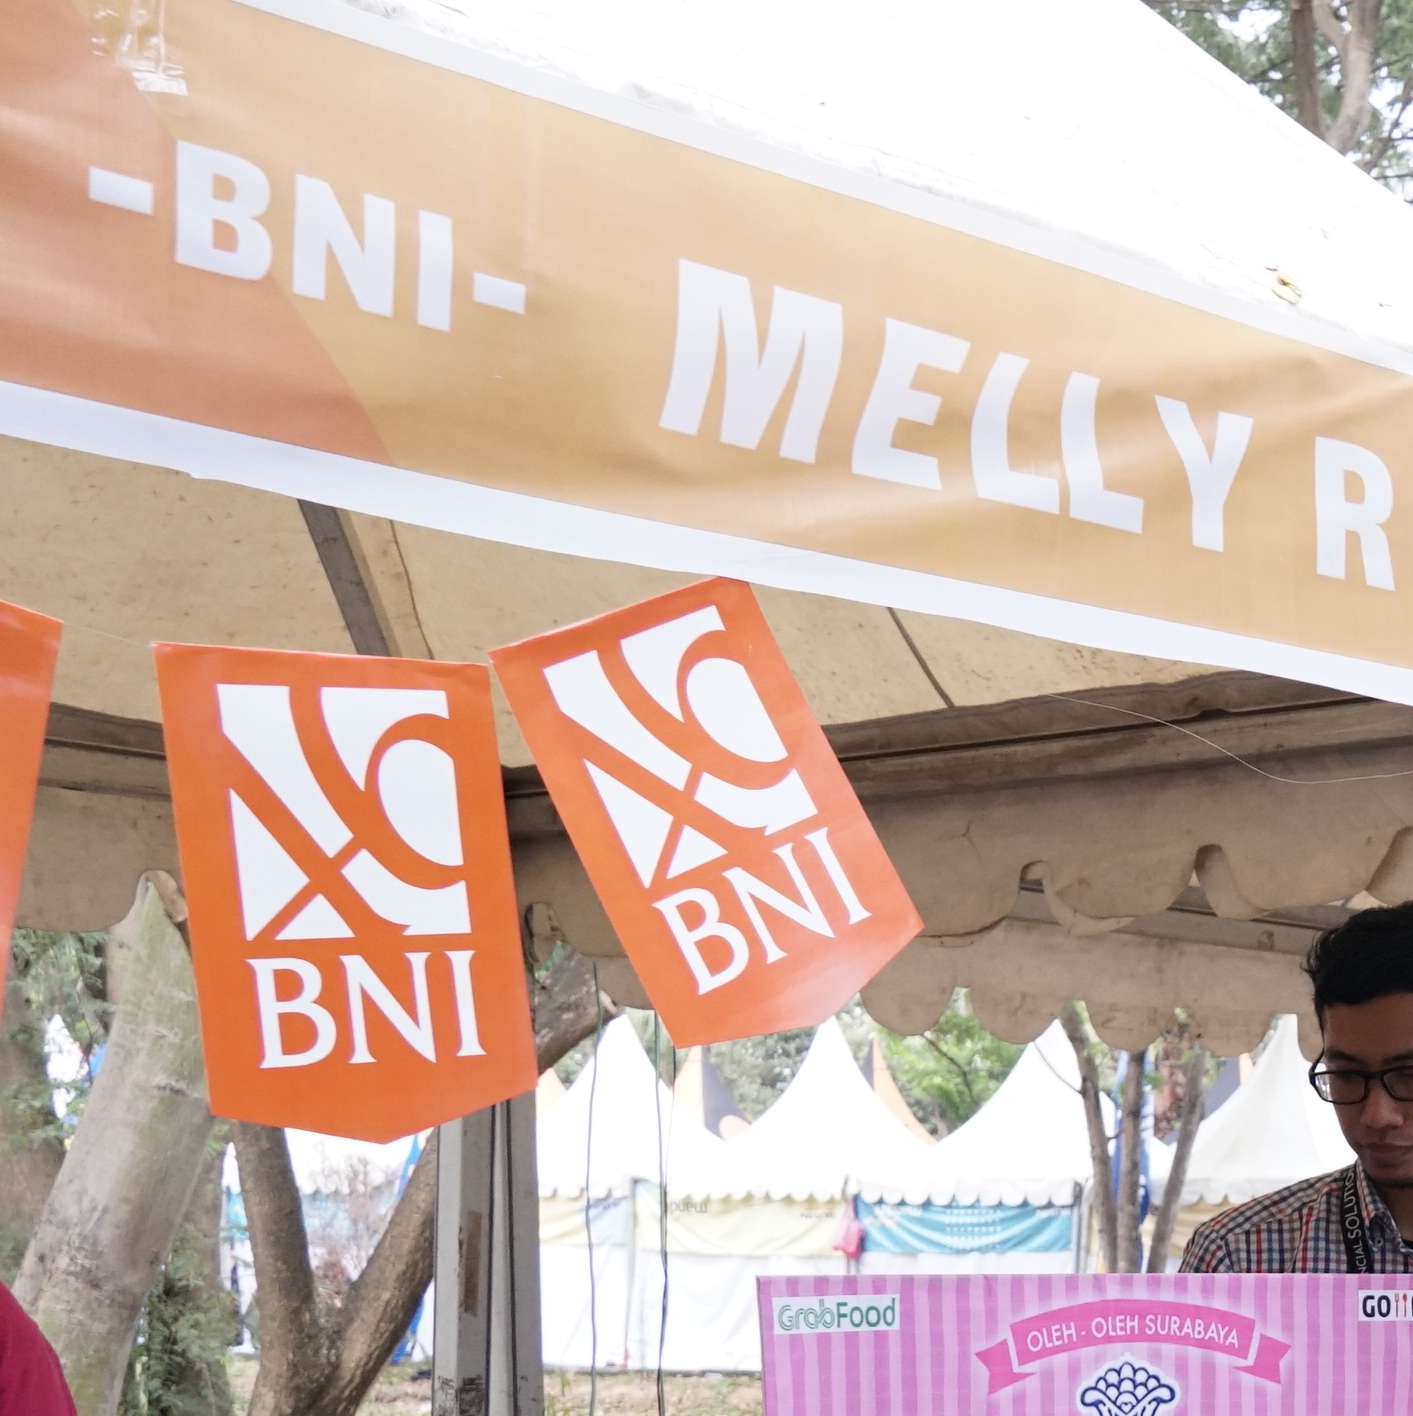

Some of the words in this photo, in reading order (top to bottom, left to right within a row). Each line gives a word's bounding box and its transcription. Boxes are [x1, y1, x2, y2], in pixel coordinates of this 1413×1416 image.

[659, 257, 1254, 553] MELLY
[653, 827, 871, 996] BNI
[246, 949, 487, 1069] BNI
[1353, 1240, 1369, 1274] NCIAL
[778, 1298, 896, 1331] GrabFood
[1027, 1324, 1076, 1353] OLEH
[1091, 1317, 1139, 1337] OLEH
[1145, 1314, 1239, 1349] SURABAYA
